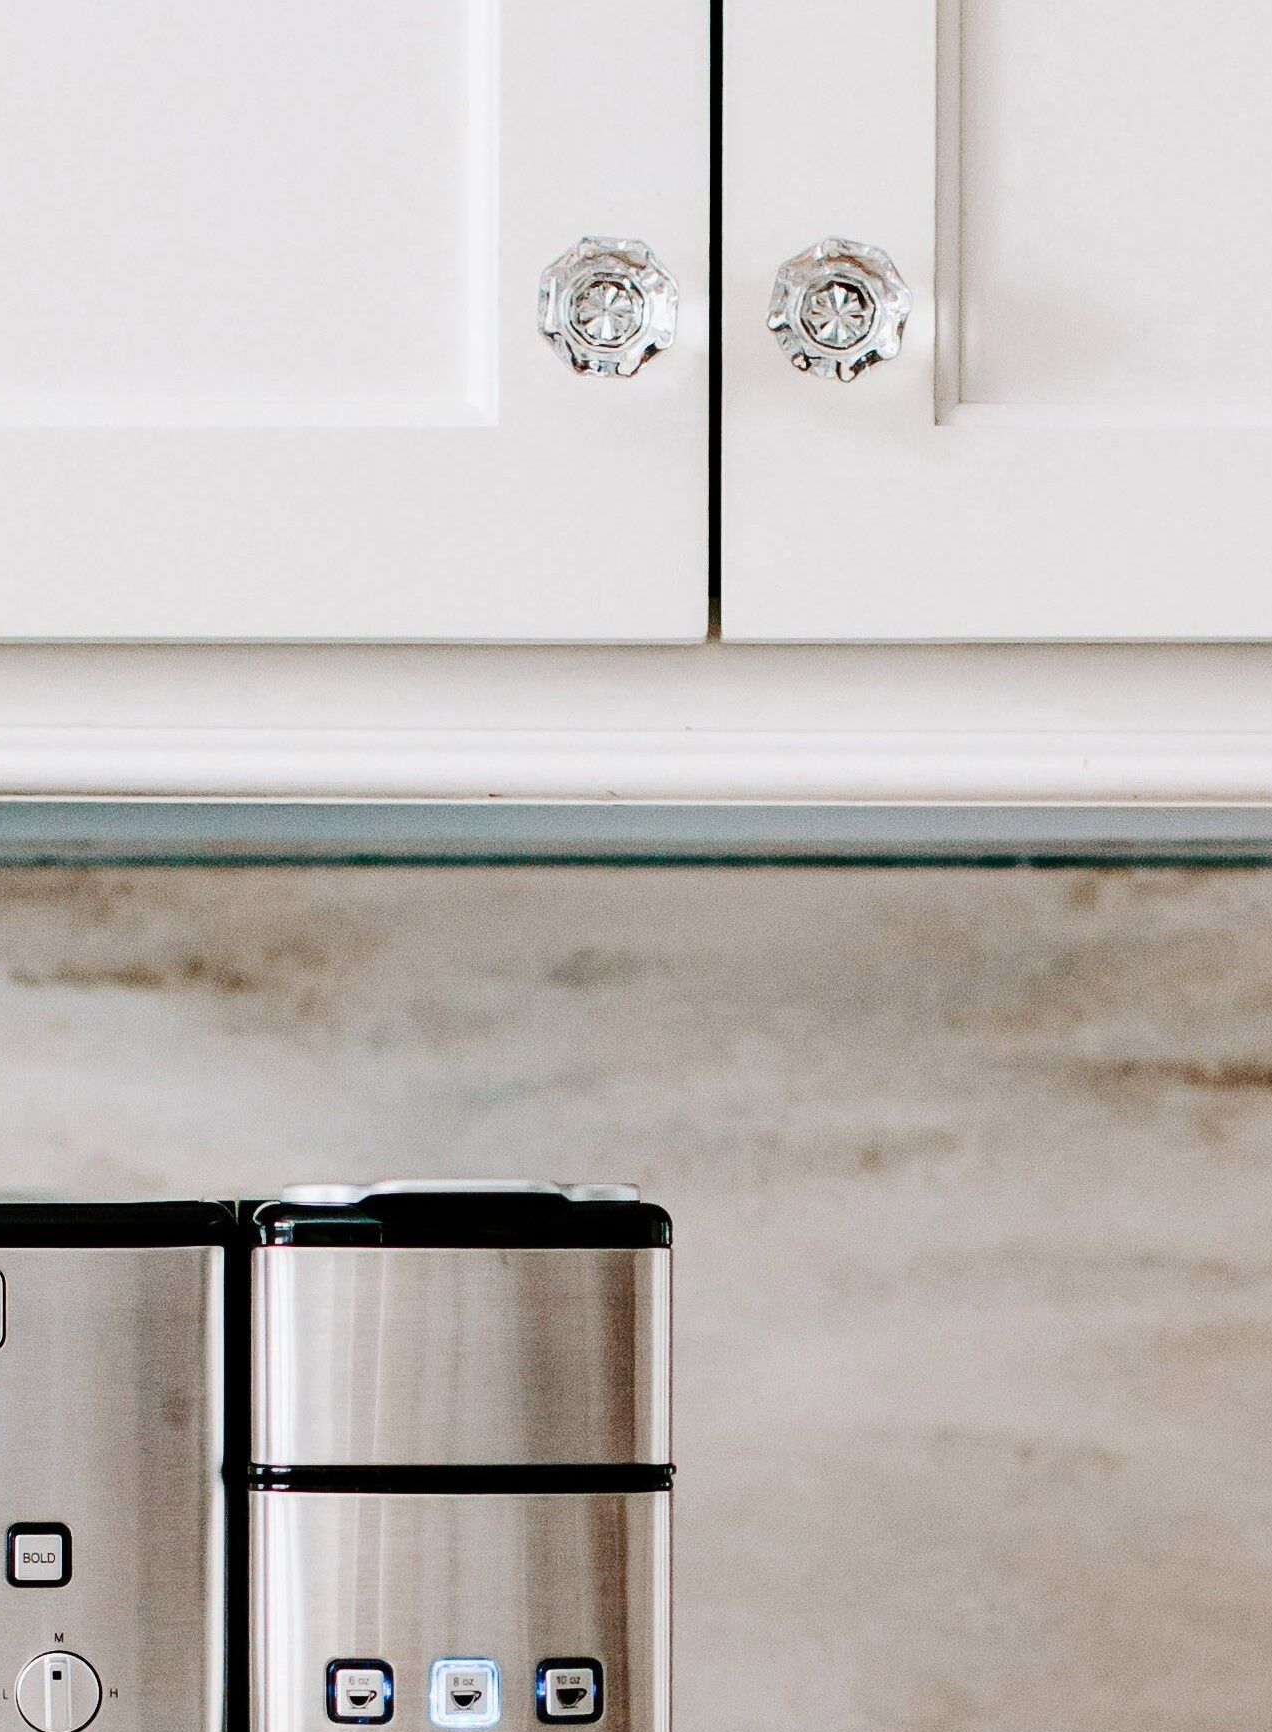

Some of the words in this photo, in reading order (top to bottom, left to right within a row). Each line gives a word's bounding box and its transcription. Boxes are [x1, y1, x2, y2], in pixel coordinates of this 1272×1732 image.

[22, 1552, 56, 1564] BOLD
[53, 1632, 65, 1643] M
[348, 1676, 356, 1686] 6
[358, 1677, 370, 1686] oz
[453, 1676, 460, 1686] 8
[462, 1677, 474, 1686] oz
[556, 1675, 567, 1685] 10
[569, 1676, 581, 1685] oz
[2, 1688, 8, 1700] L
[109, 1687, 119, 1698] H
